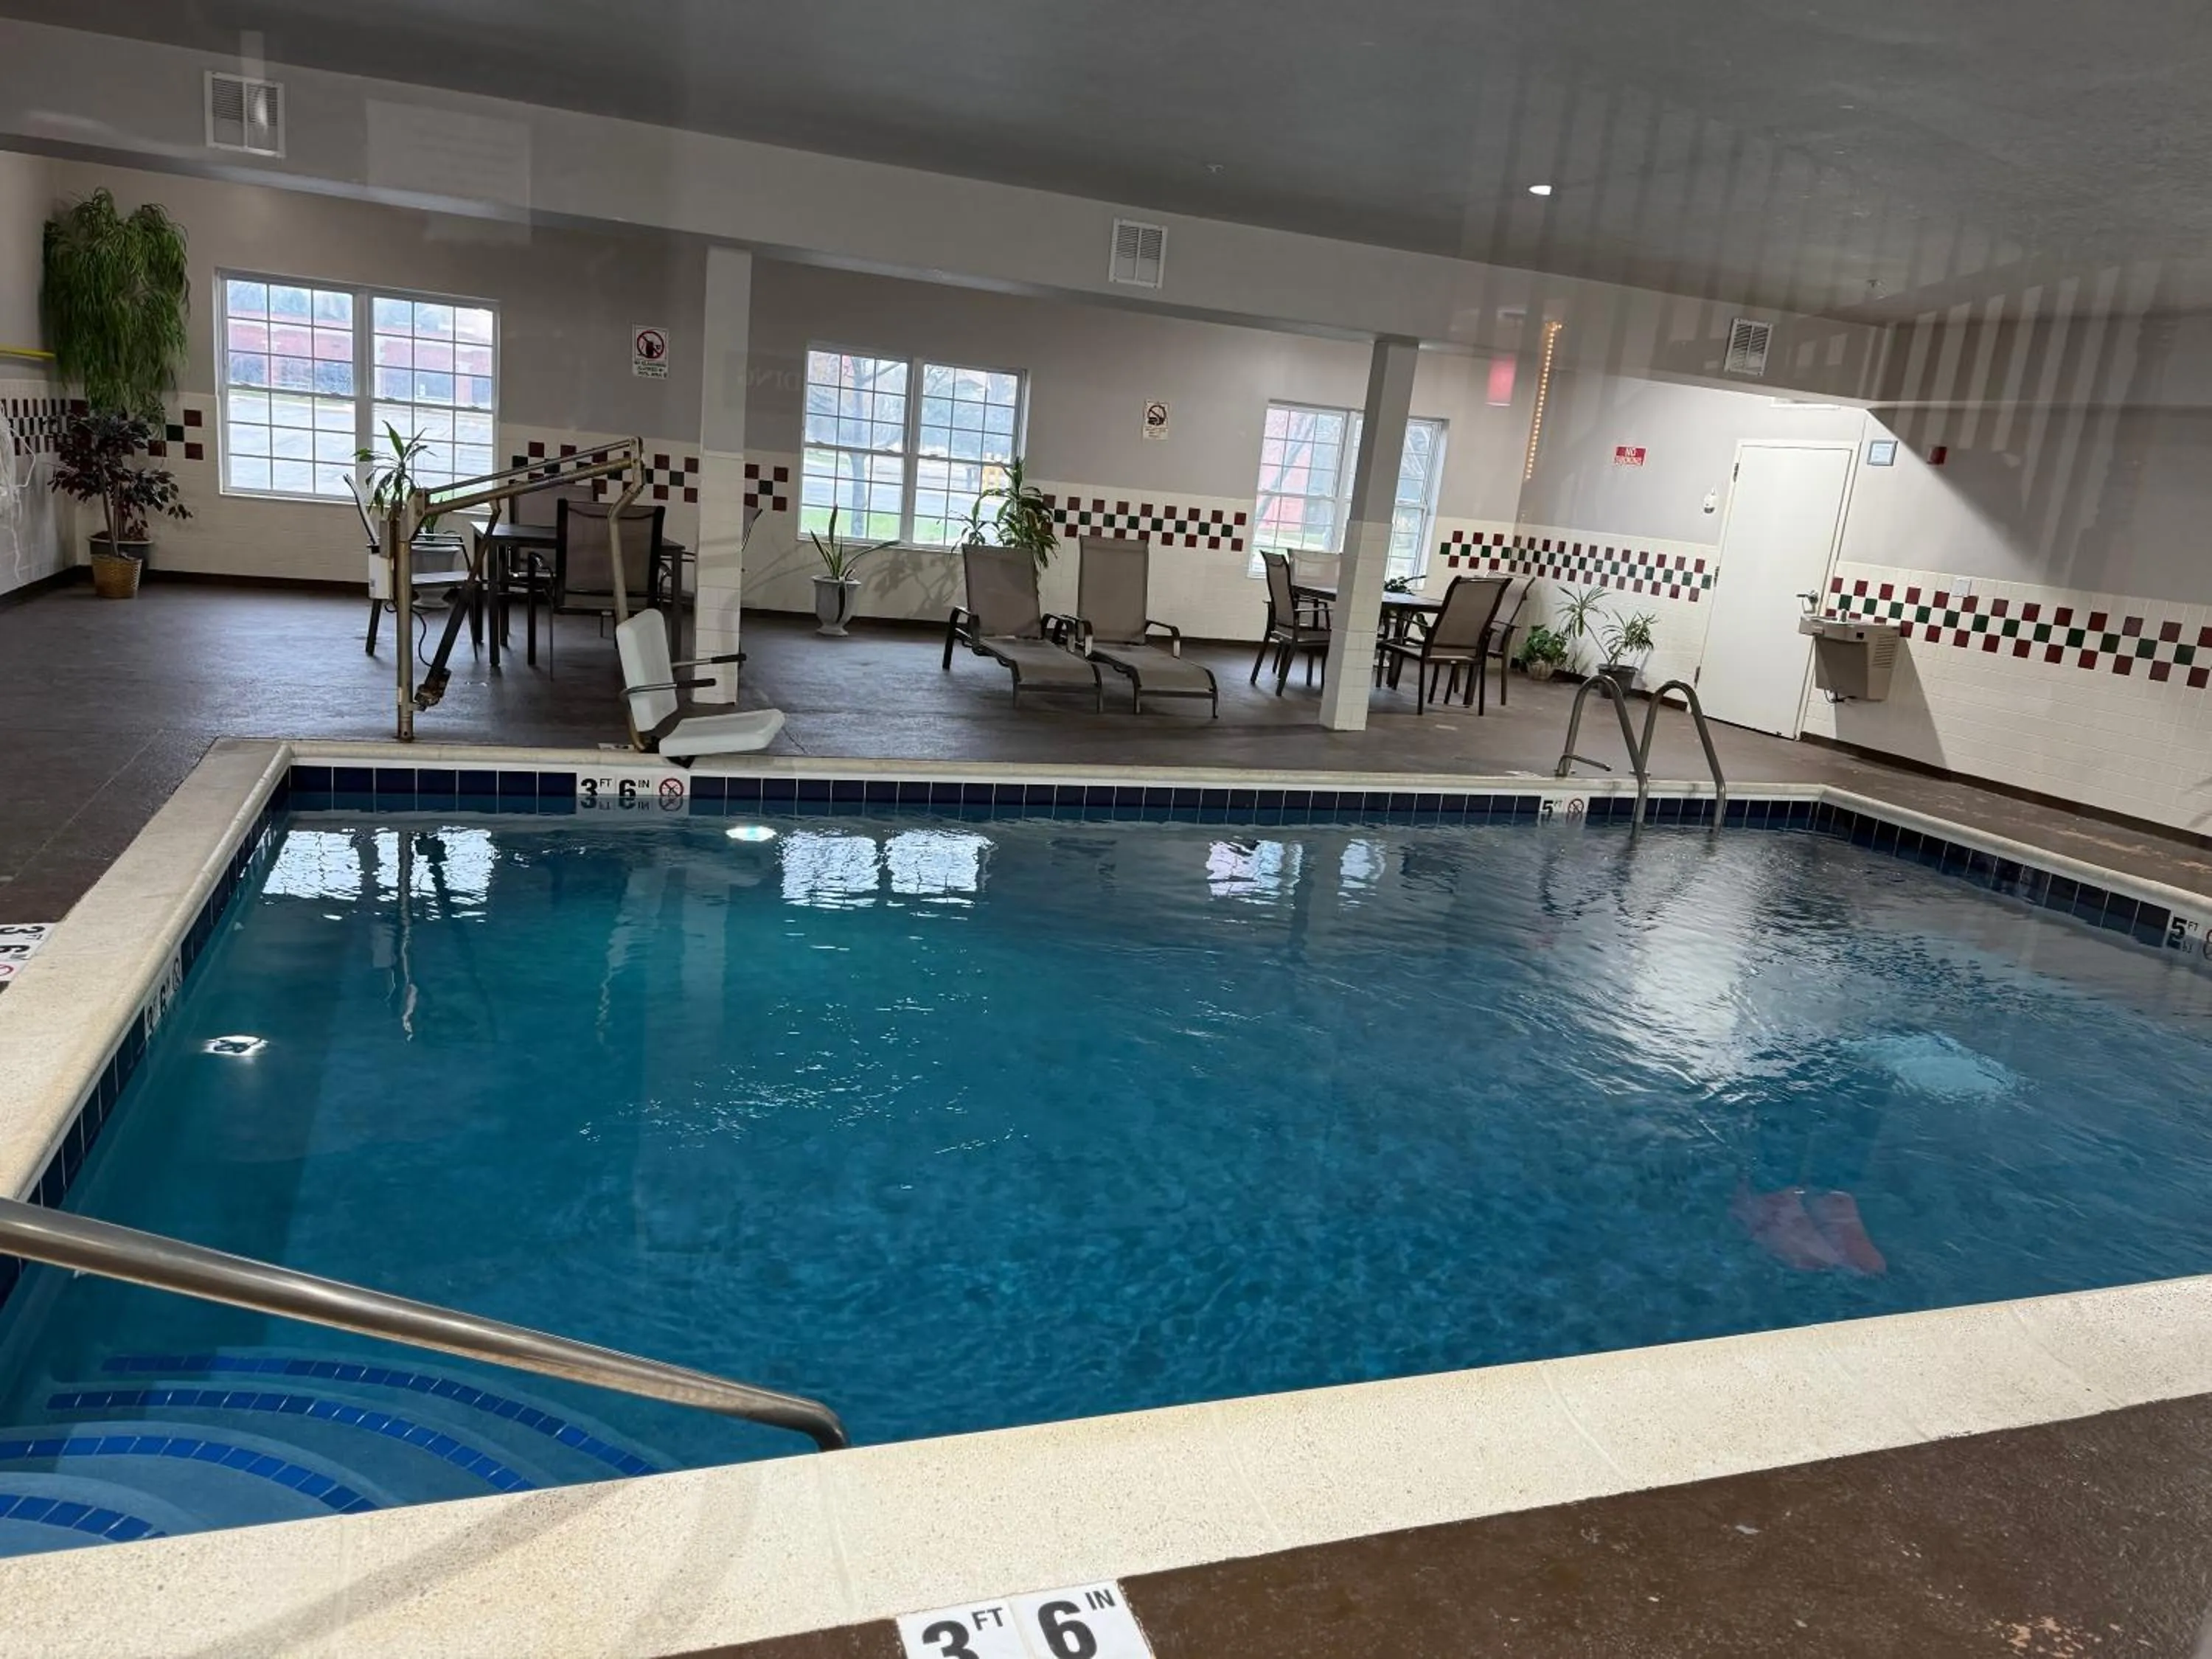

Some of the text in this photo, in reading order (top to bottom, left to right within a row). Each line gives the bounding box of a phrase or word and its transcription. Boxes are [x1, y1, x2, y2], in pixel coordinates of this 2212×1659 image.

[580, 778, 650, 798] 3 FT 6 IN
[922, 1589, 1116, 1658] 3 FT 6 IN
